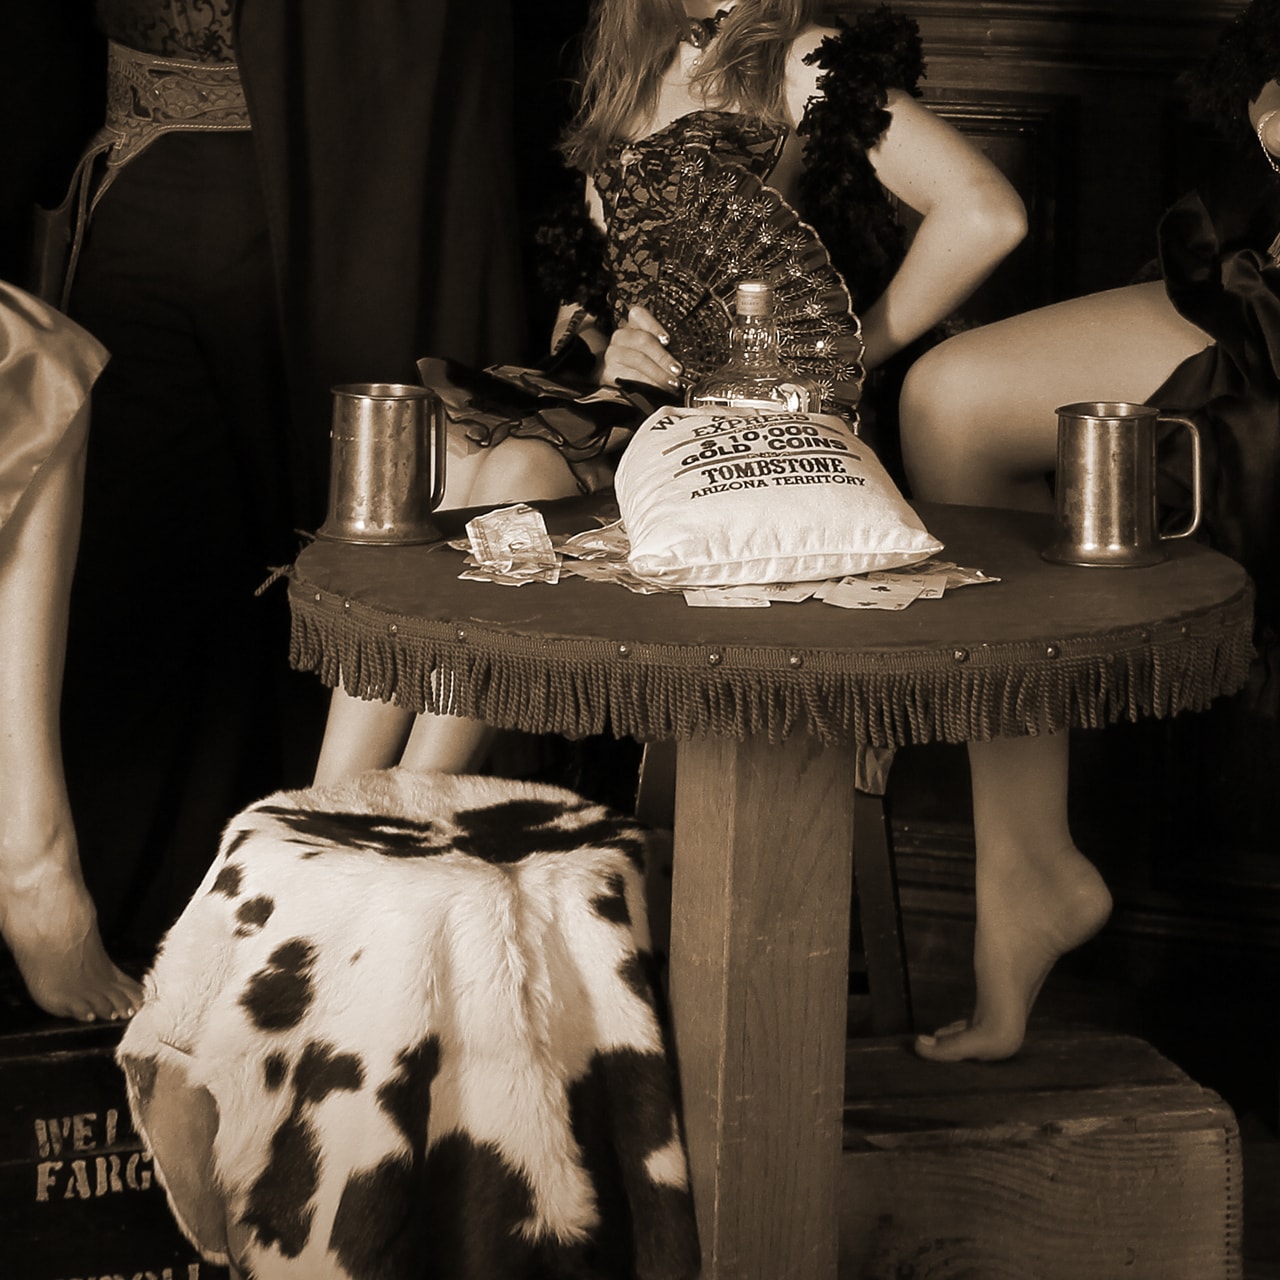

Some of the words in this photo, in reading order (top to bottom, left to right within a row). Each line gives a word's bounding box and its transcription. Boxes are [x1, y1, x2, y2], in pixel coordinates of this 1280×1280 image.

[691, 413, 811, 438] EXPRESS
[680, 443, 753, 467] GOLD
[767, 436, 849, 451] COINS
[700, 456, 848, 486] TOMBSTONE
[690, 479, 770, 500] ARIZONA
[771, 474, 867, 487] TERRITORY
